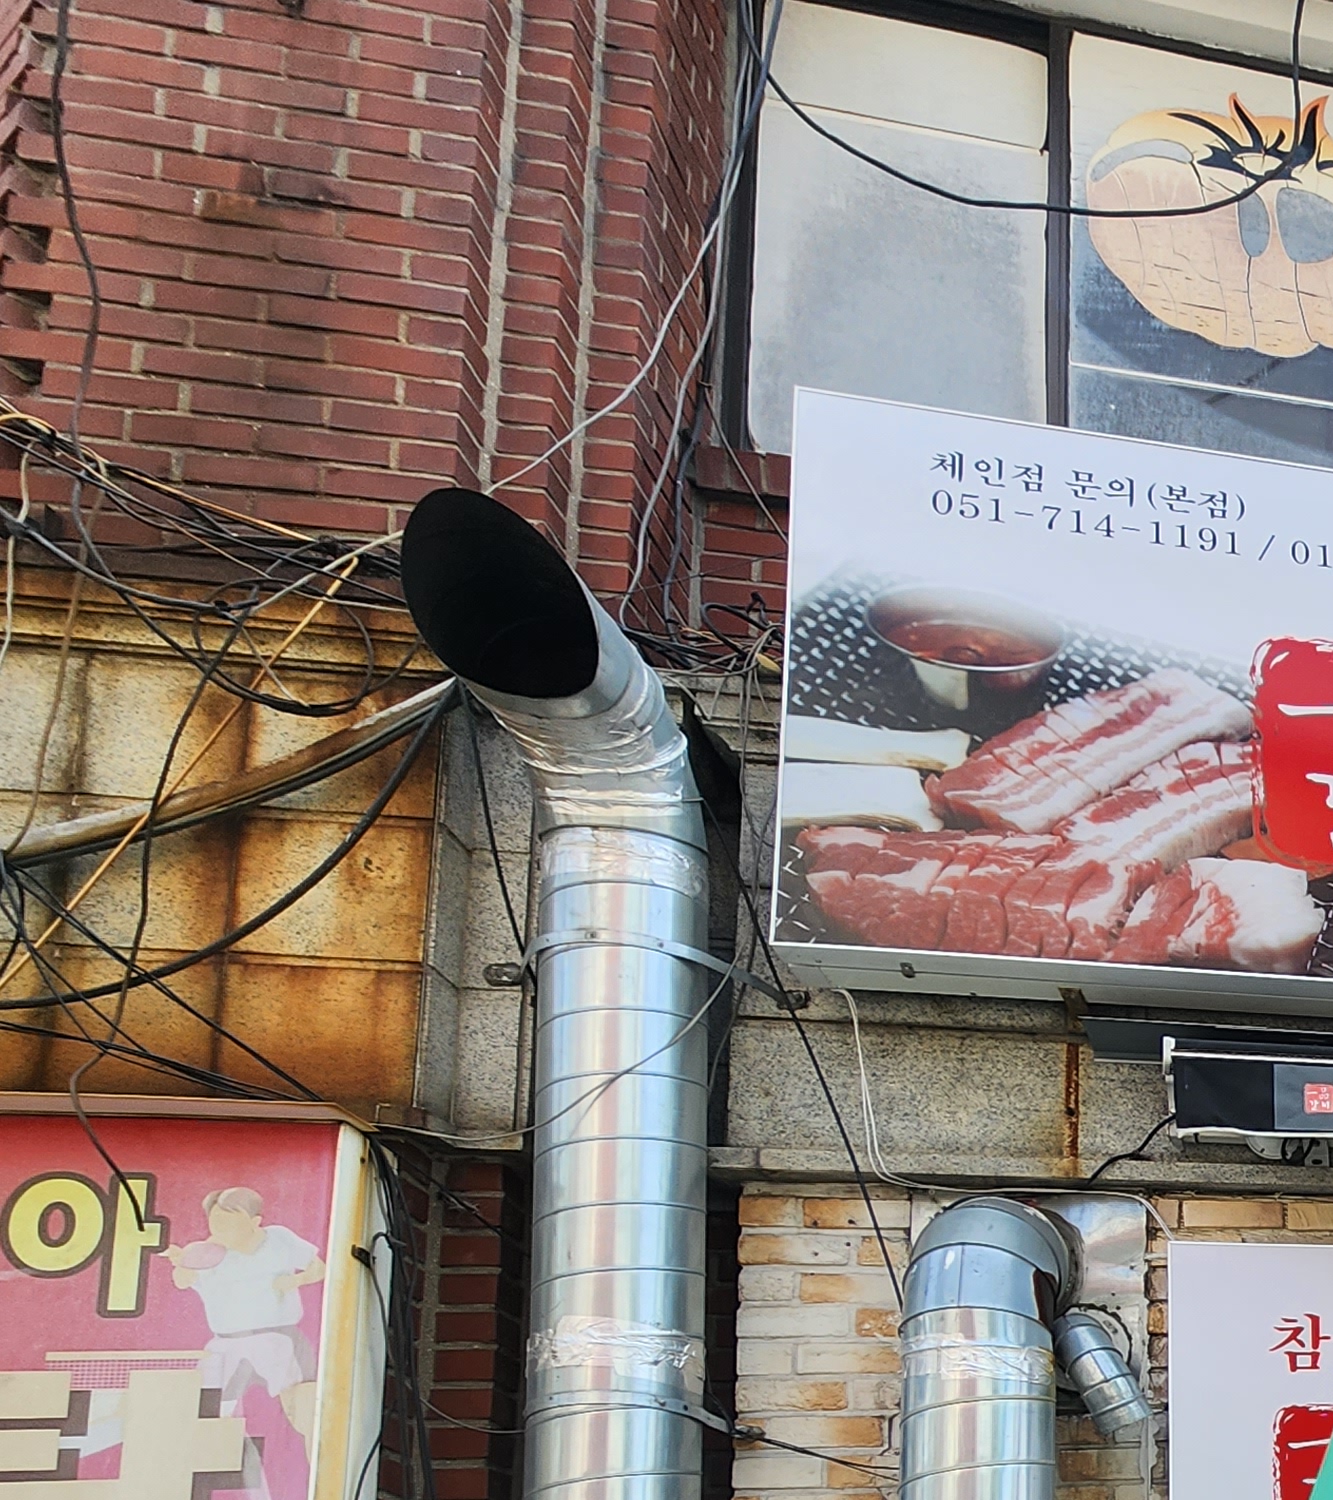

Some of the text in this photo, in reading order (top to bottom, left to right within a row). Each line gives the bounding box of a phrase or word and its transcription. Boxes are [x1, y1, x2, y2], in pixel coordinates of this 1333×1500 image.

[930, 450, 1248, 522] 체인점 문의(본점)
[931, 489, 1241, 560] 051-714-1191
[1258, 533, 1276, 564] /
